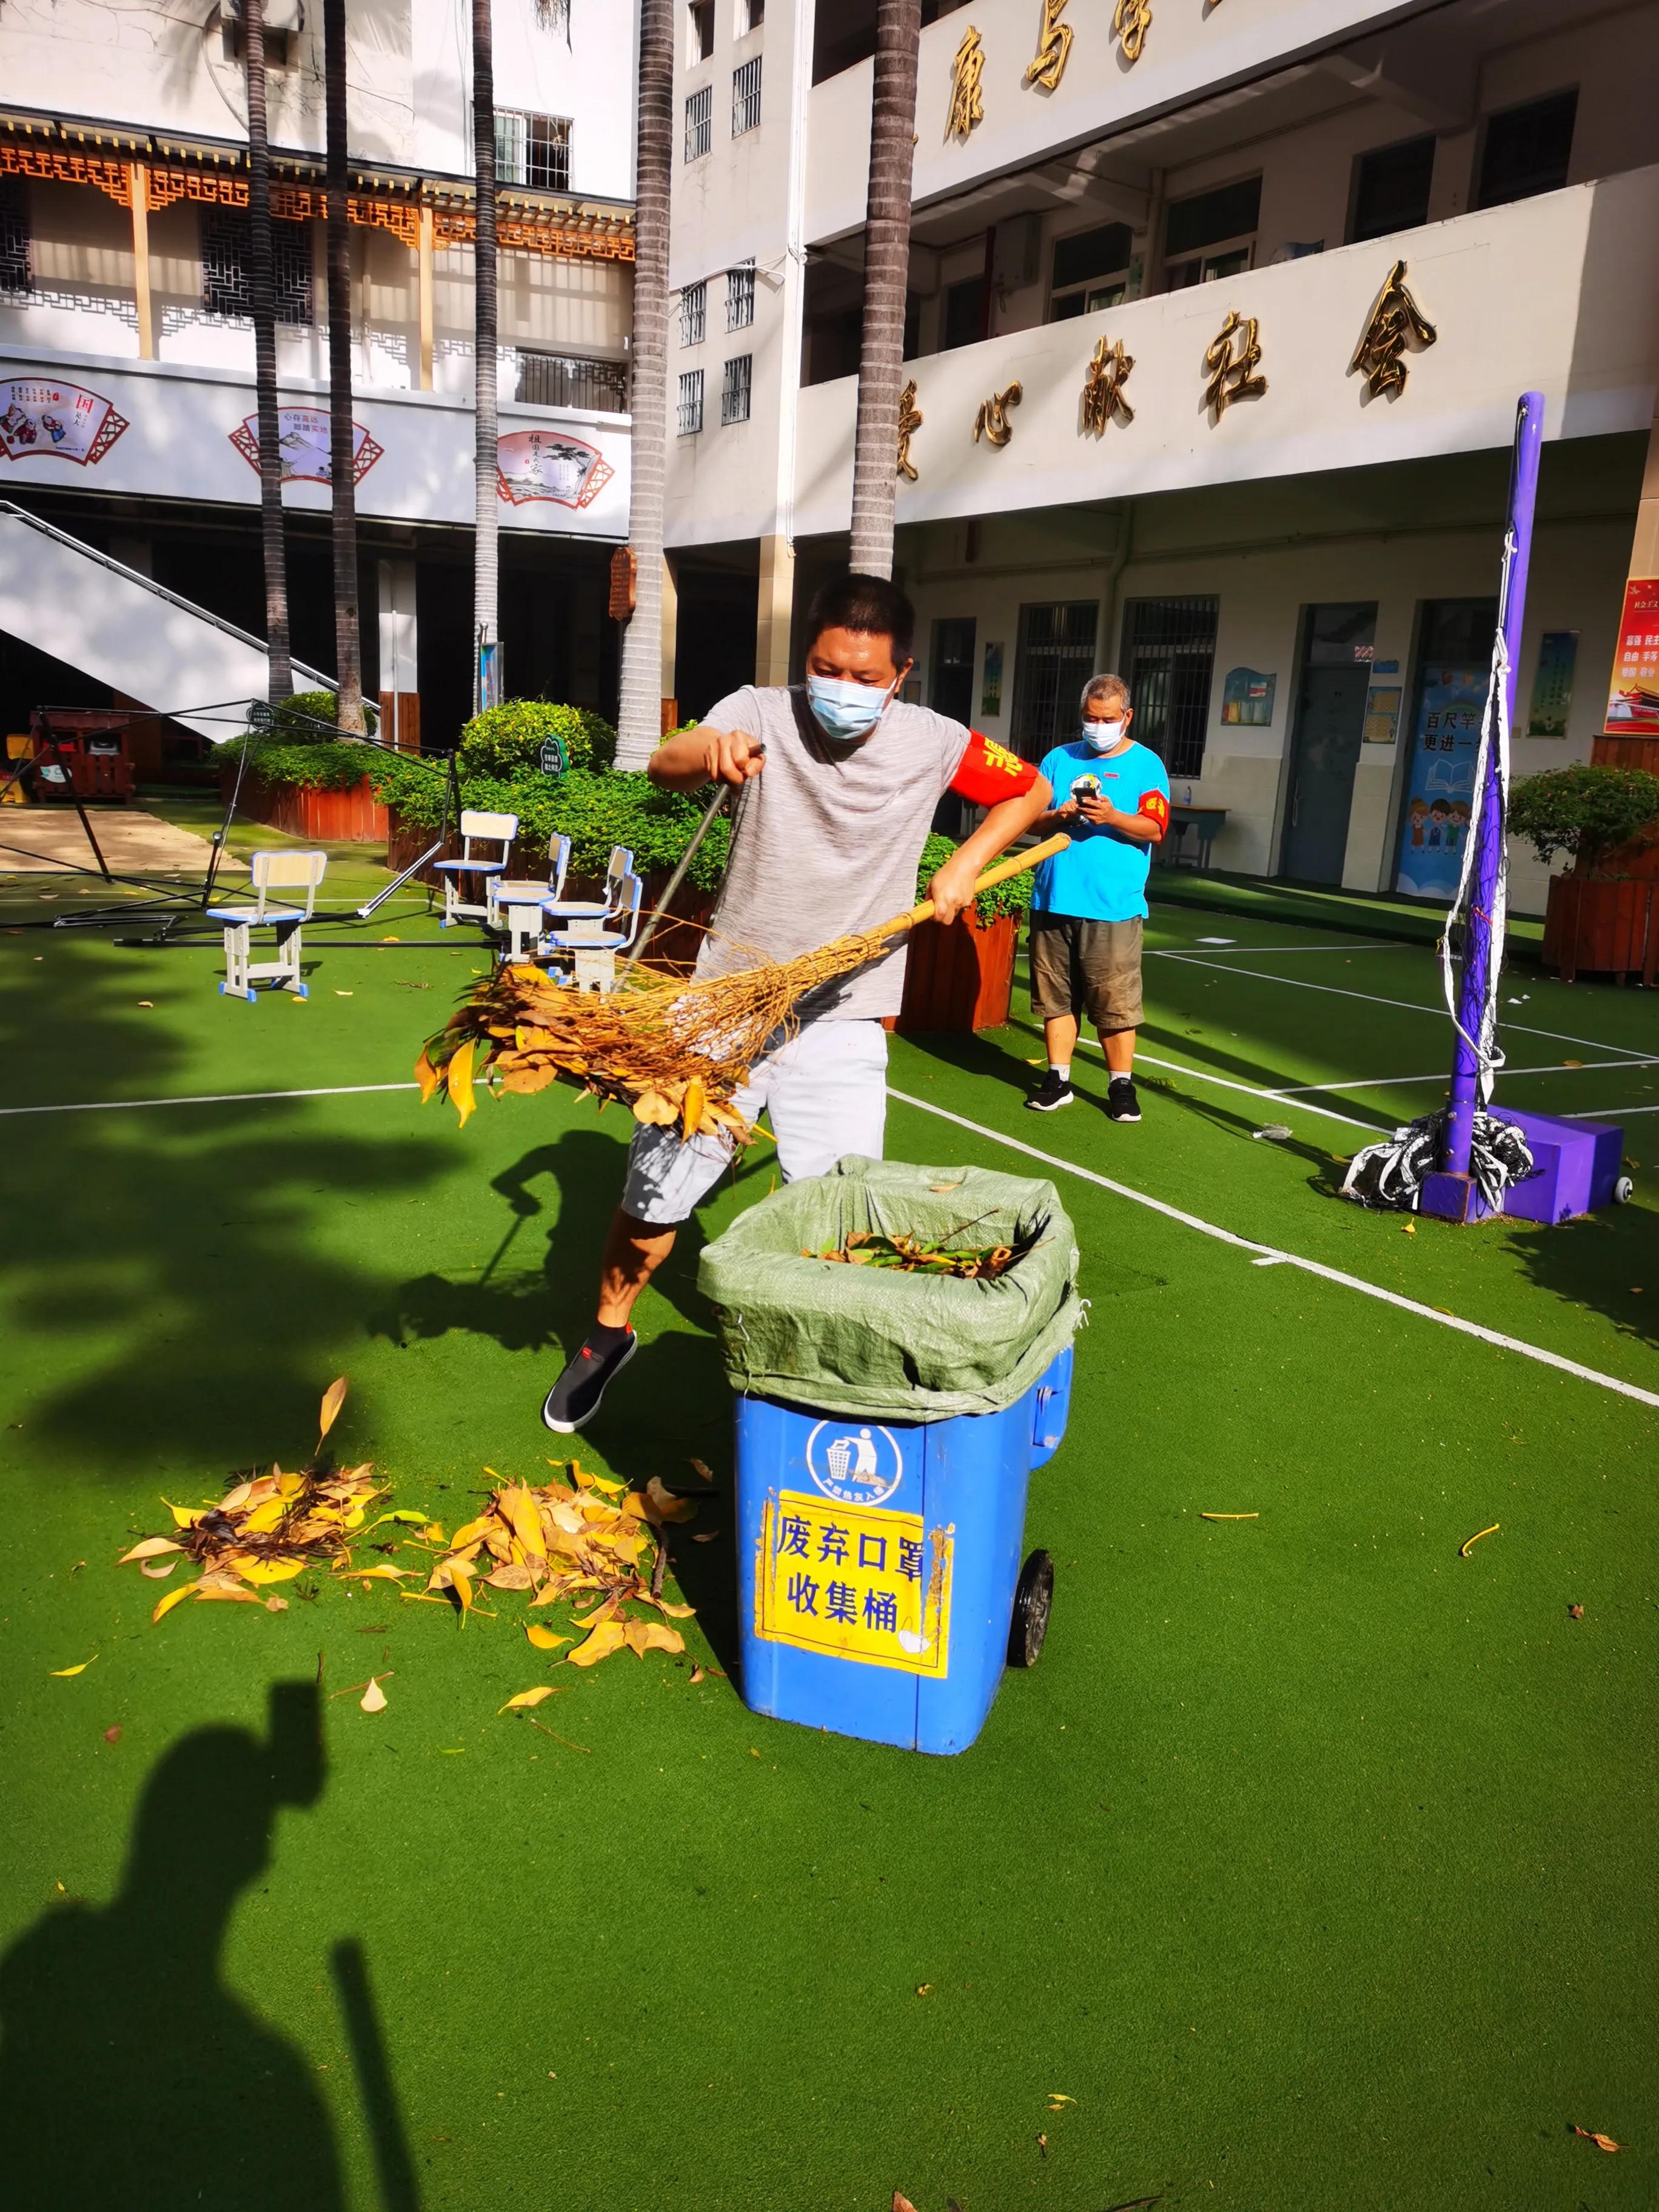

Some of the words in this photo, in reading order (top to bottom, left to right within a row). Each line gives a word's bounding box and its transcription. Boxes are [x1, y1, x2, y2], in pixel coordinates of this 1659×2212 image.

[1623, 651, 1639, 662] 自由
[777, 1514, 923, 1583] 废弃口罩
[787, 1572, 898, 1634] 收集桶
